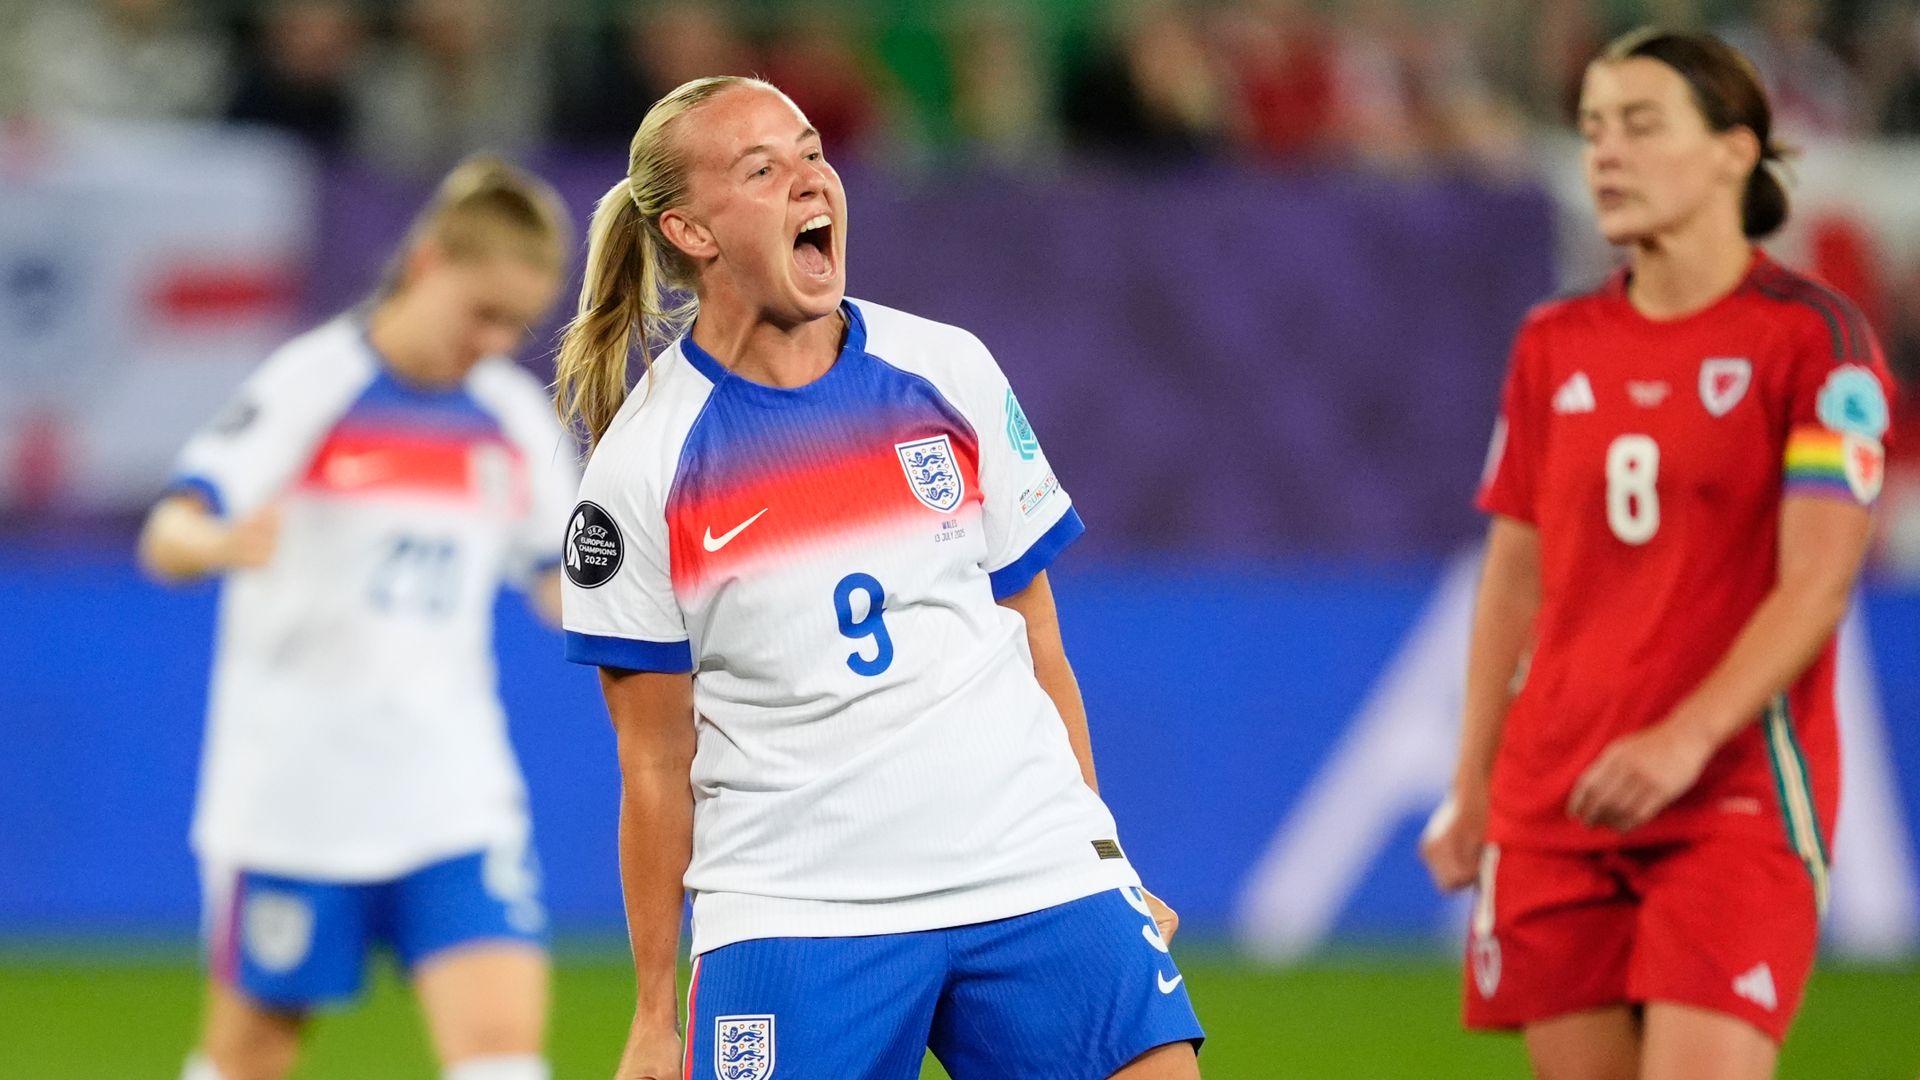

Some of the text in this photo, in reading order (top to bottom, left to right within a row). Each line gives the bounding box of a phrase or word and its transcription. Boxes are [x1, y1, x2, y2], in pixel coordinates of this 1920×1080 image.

[1606, 434, 1660, 544] 8
[942, 519, 958, 530] WALES
[587, 526, 606, 538] UEFA
[942, 531, 954, 542] JULY
[580, 536, 615, 548] EUROPEAN
[579, 544, 617, 556] CHAMPIONS
[584, 555, 608, 565] 2022
[833, 572, 894, 677] 9
